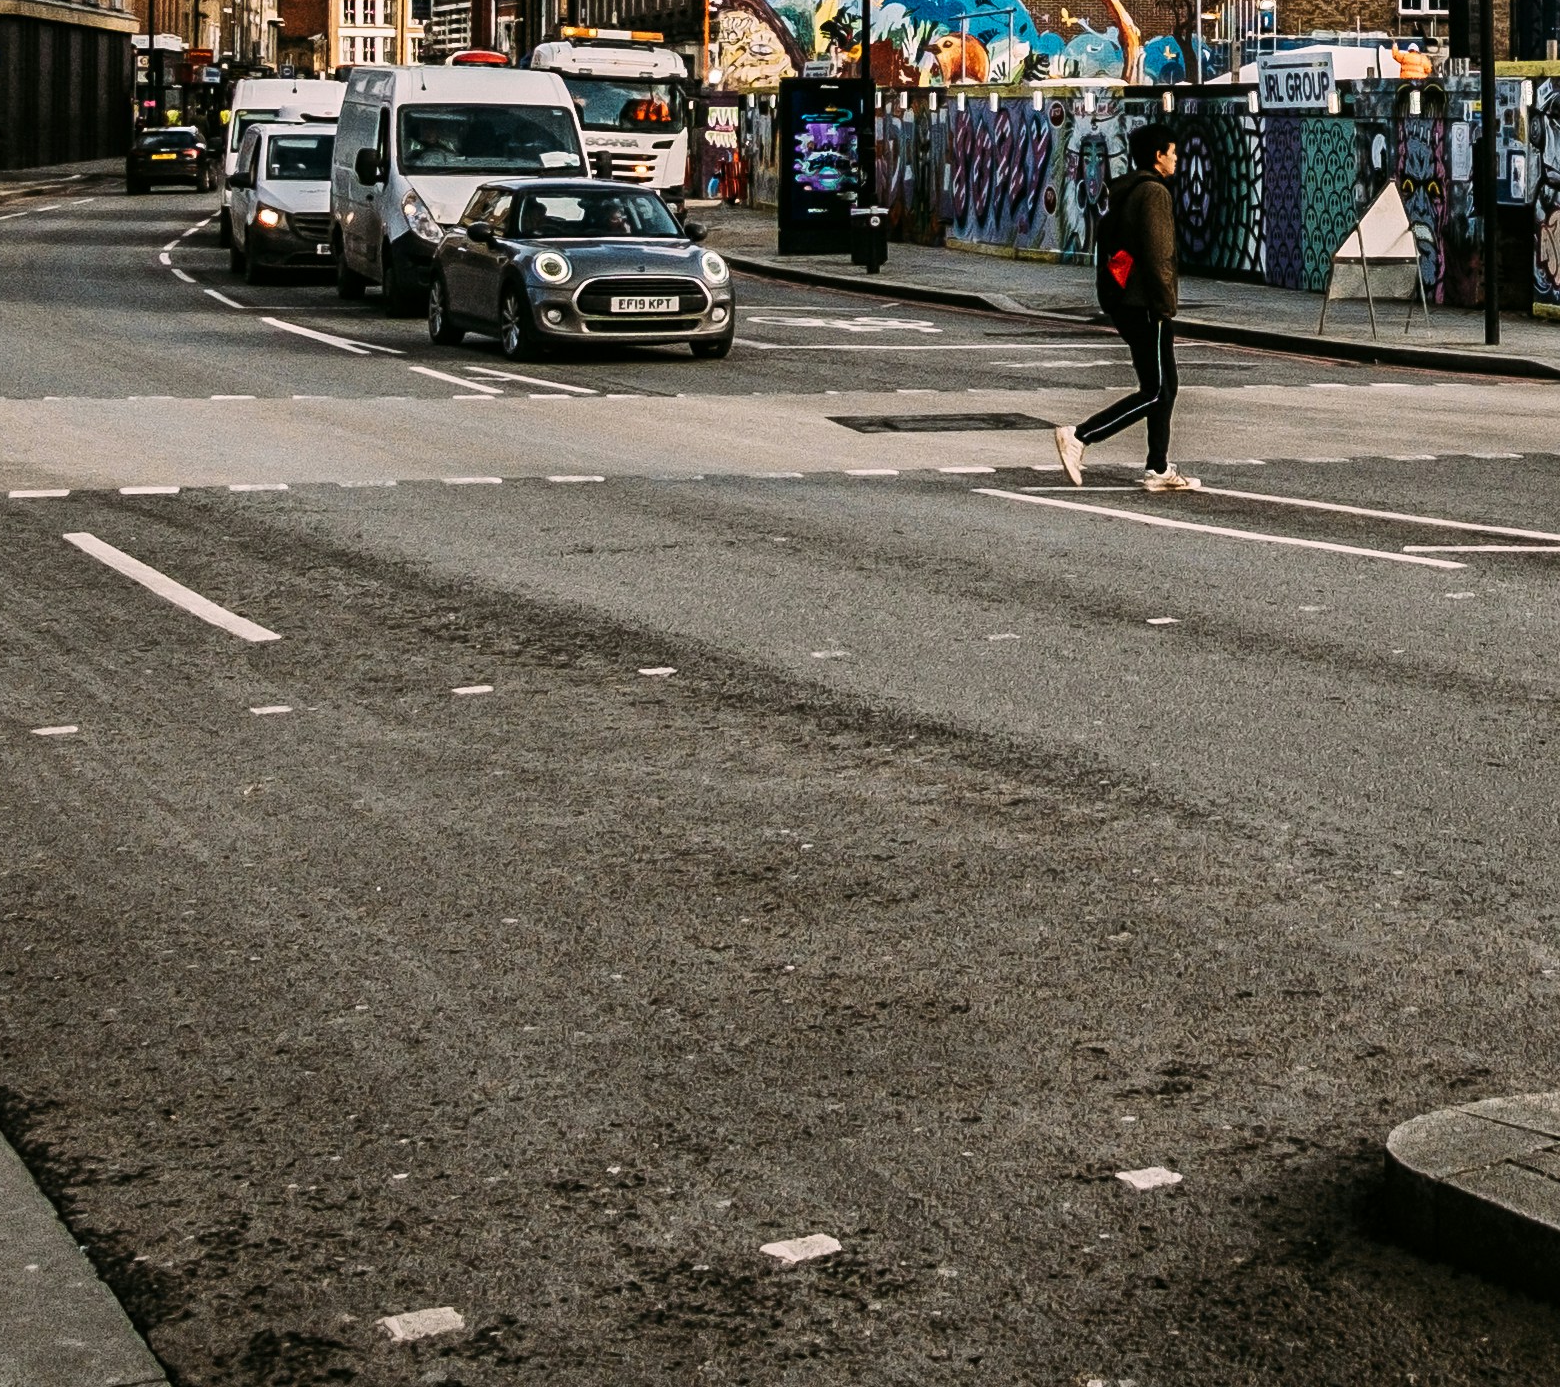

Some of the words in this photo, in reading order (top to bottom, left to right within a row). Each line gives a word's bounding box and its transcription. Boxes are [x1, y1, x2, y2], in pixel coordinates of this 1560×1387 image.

[1264, 73, 1284, 102] JRL
[1285, 70, 1330, 103] GROUP
[585, 136, 639, 148] SCANIA
[648, 298, 672, 310] KPT
